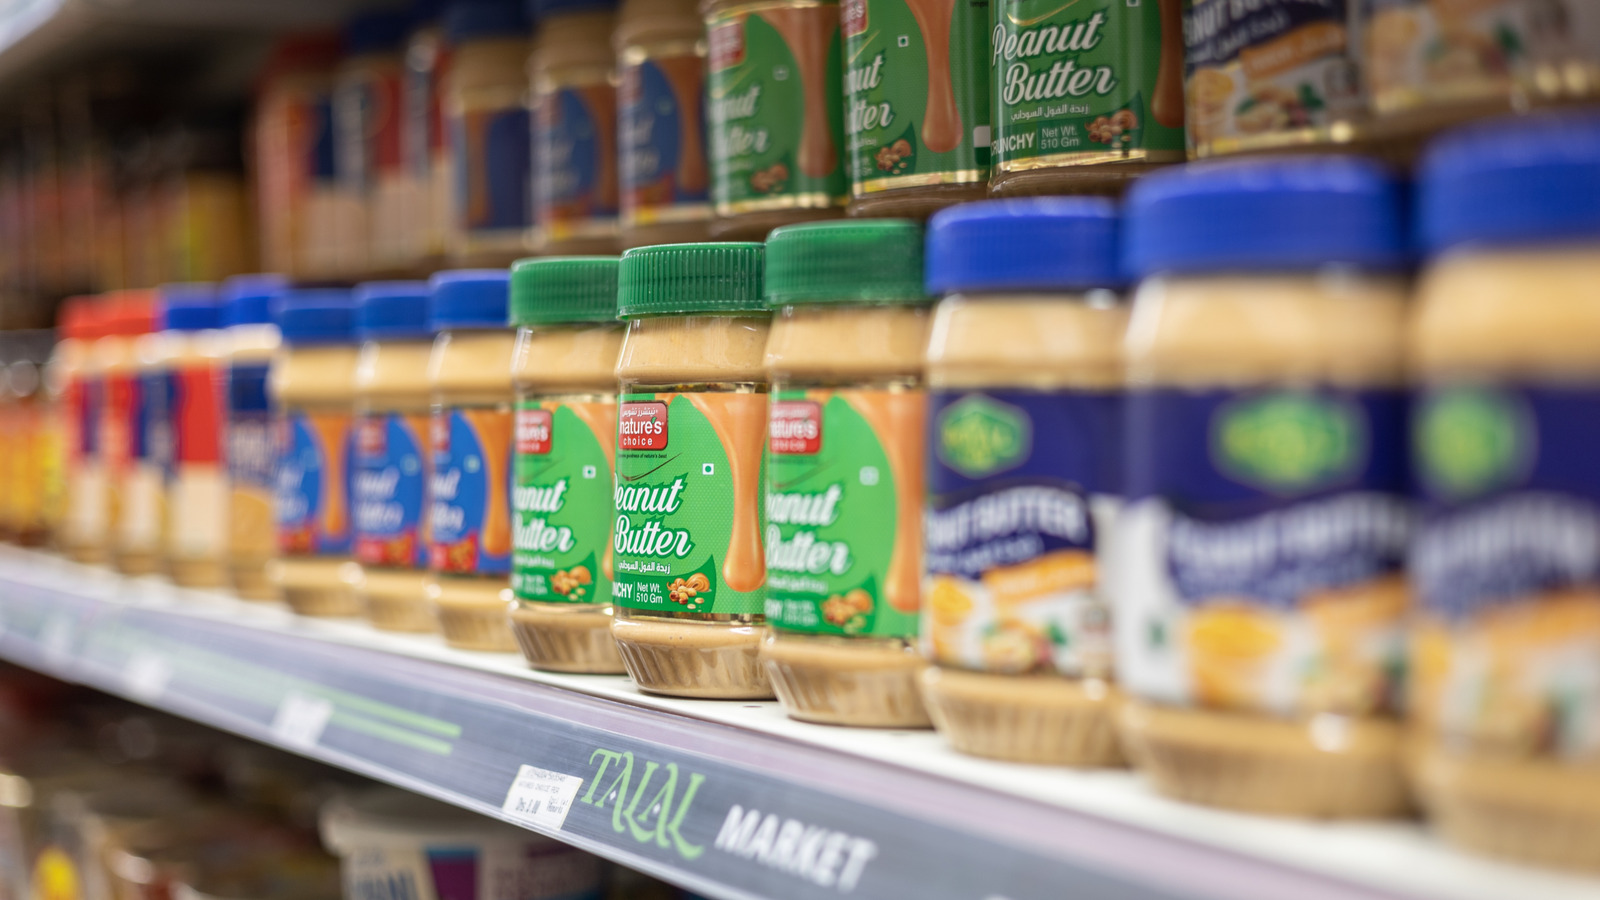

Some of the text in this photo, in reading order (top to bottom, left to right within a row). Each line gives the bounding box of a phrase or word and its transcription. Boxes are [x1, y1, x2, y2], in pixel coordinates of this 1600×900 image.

[992, 12, 1104, 66] Peanut
[1003, 61, 1115, 105] Butter
[1011, 103, 1088, 122] زبدة الفول السوداني
[1041, 125, 1077, 138] Net Wt.
[1041, 137, 1079, 149] 510 Gm
[620, 418, 662, 434] nature's
[623, 436, 653, 446] choice
[615, 514, 692, 556] Butter
[656, 562, 671, 575] زبدة
[637, 581, 662, 593] Net Wt.
[636, 592, 663, 604] 510 Gm
[714, 804, 880, 894] MARKET
